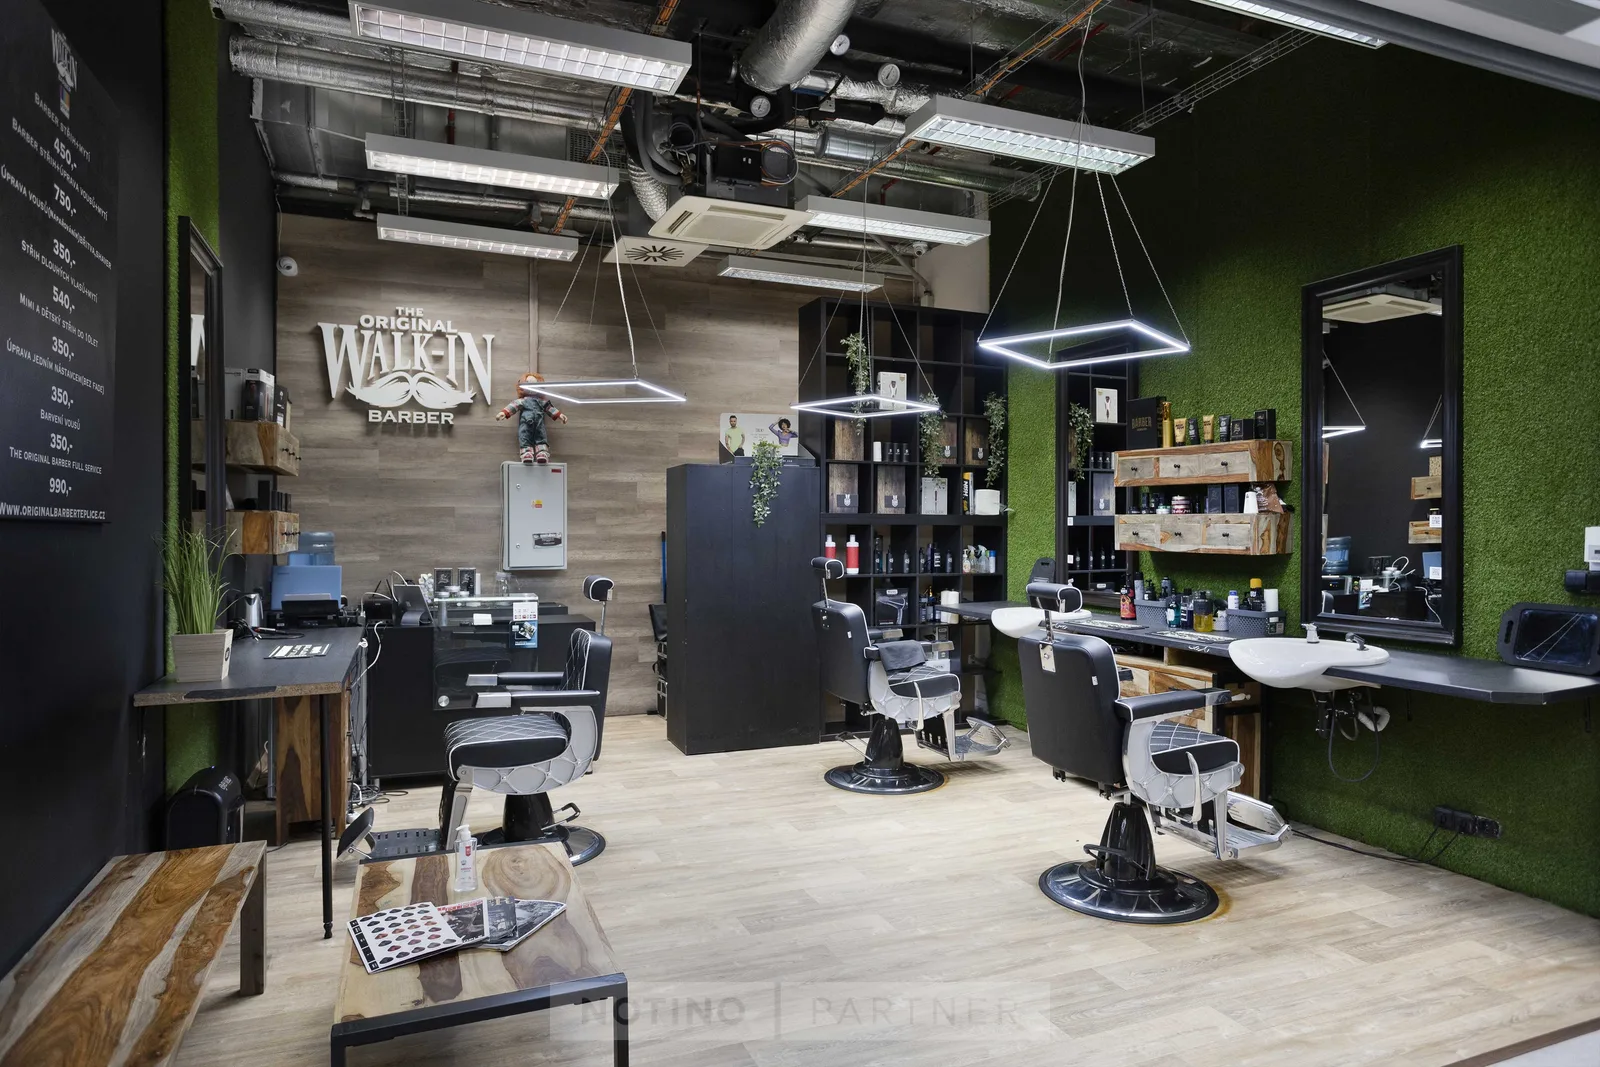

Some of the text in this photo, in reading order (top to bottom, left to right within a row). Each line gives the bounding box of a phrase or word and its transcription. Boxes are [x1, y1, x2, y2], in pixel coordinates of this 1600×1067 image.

[34, 92, 59, 127] BARBER
[12, 117, 38, 151] BARBER
[54, 137, 77, 171] 450,-
[1, 164, 27, 197] ÚPRAVA
[54, 184, 77, 217] 750,-
[21, 240, 40, 261] STŘIH
[41, 255, 70, 282] DLOUHÝCH
[53, 238, 76, 269] 350,-
[52, 285, 75, 311] 540,-
[396, 306, 424, 317] THE
[20, 293, 35, 311] MIMI
[36, 303, 40, 313] A
[77, 328, 84, 339] DO
[359, 315, 458, 333] ORIGINAL
[6, 337, 31, 361] ÚPRAVA
[52, 336, 75, 361] 350,-
[317, 322, 495, 406] WALK-IN
[51, 385, 74, 409] 350,-
[40, 408, 81, 430] BARVENÍ VOUSŮ
[368, 409, 454, 425] BARBER
[50, 433, 73, 454] 350,-
[9, 446, 102, 474] THE ORIGINAL BARBER FULL SERVICE
[49, 477, 72, 497] 990,-
